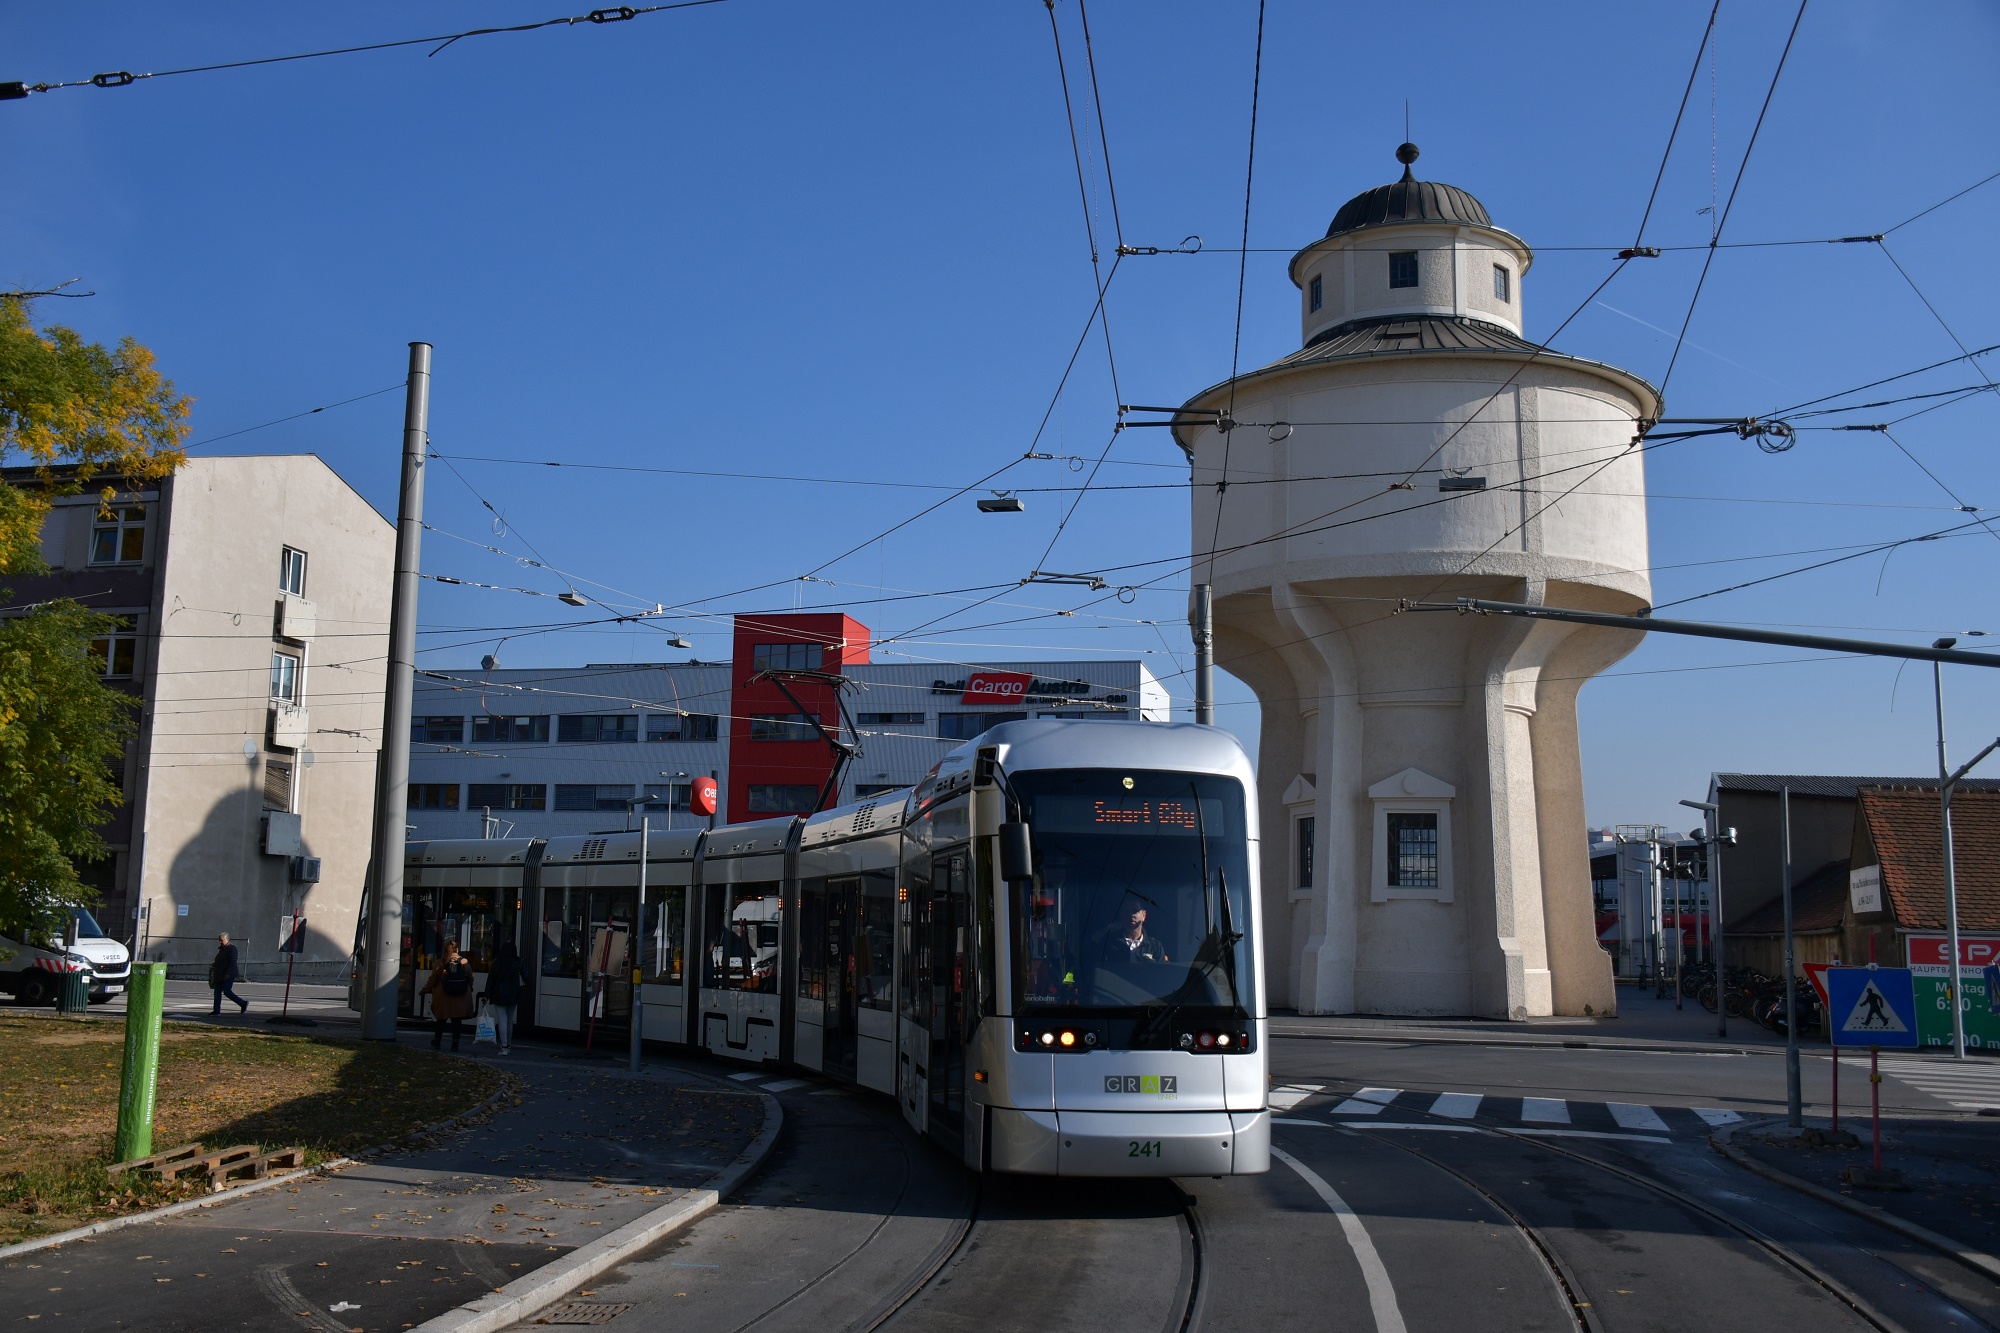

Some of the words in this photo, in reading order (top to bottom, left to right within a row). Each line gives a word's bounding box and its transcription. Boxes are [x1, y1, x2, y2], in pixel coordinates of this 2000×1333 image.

[971, 678, 1023, 696] Cargo
[1027, 679, 1090, 694] Austria
[1094, 801, 1151, 823] Smart
[1158, 802, 1195, 828] City
[1936, 996, 1971, 1011] 6:0
[1927, 1034, 1941, 1046] in
[1106, 1076, 1175, 1093] GRAZ
[145, 1067, 156, 1125] TRINKBRUNNEN
[1128, 1141, 1161, 1157] 241
